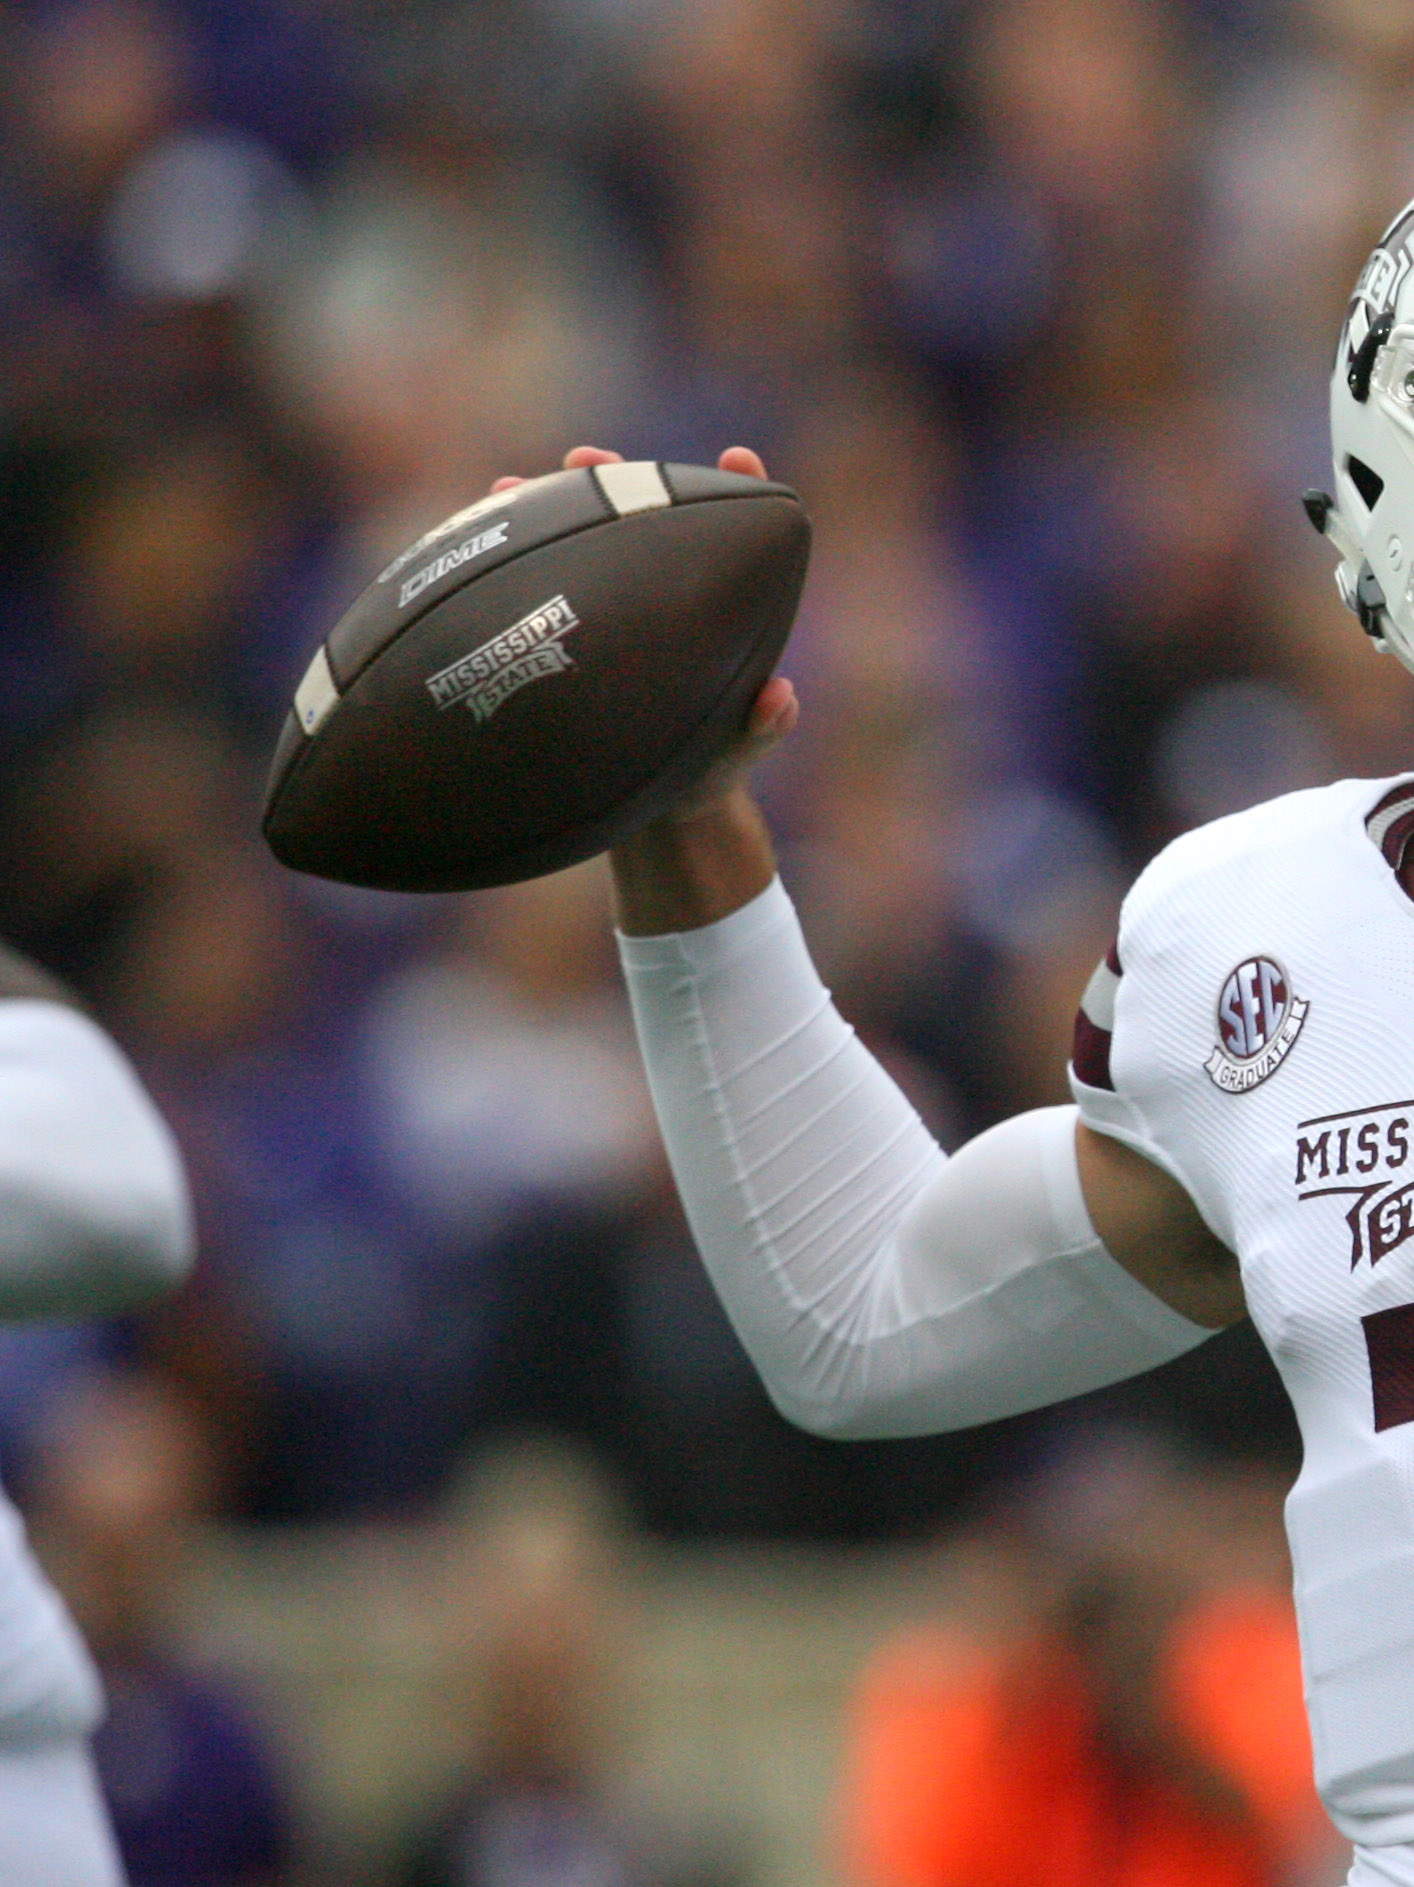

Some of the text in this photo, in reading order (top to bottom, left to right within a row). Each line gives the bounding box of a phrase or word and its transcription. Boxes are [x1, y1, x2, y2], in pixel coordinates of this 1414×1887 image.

[427, 599, 577, 705] MISSISSIPPI
[478, 655, 553, 709] STATE
[1219, 960, 1286, 1057] SEC
[1219, 1028, 1295, 1089] GRADUATE
